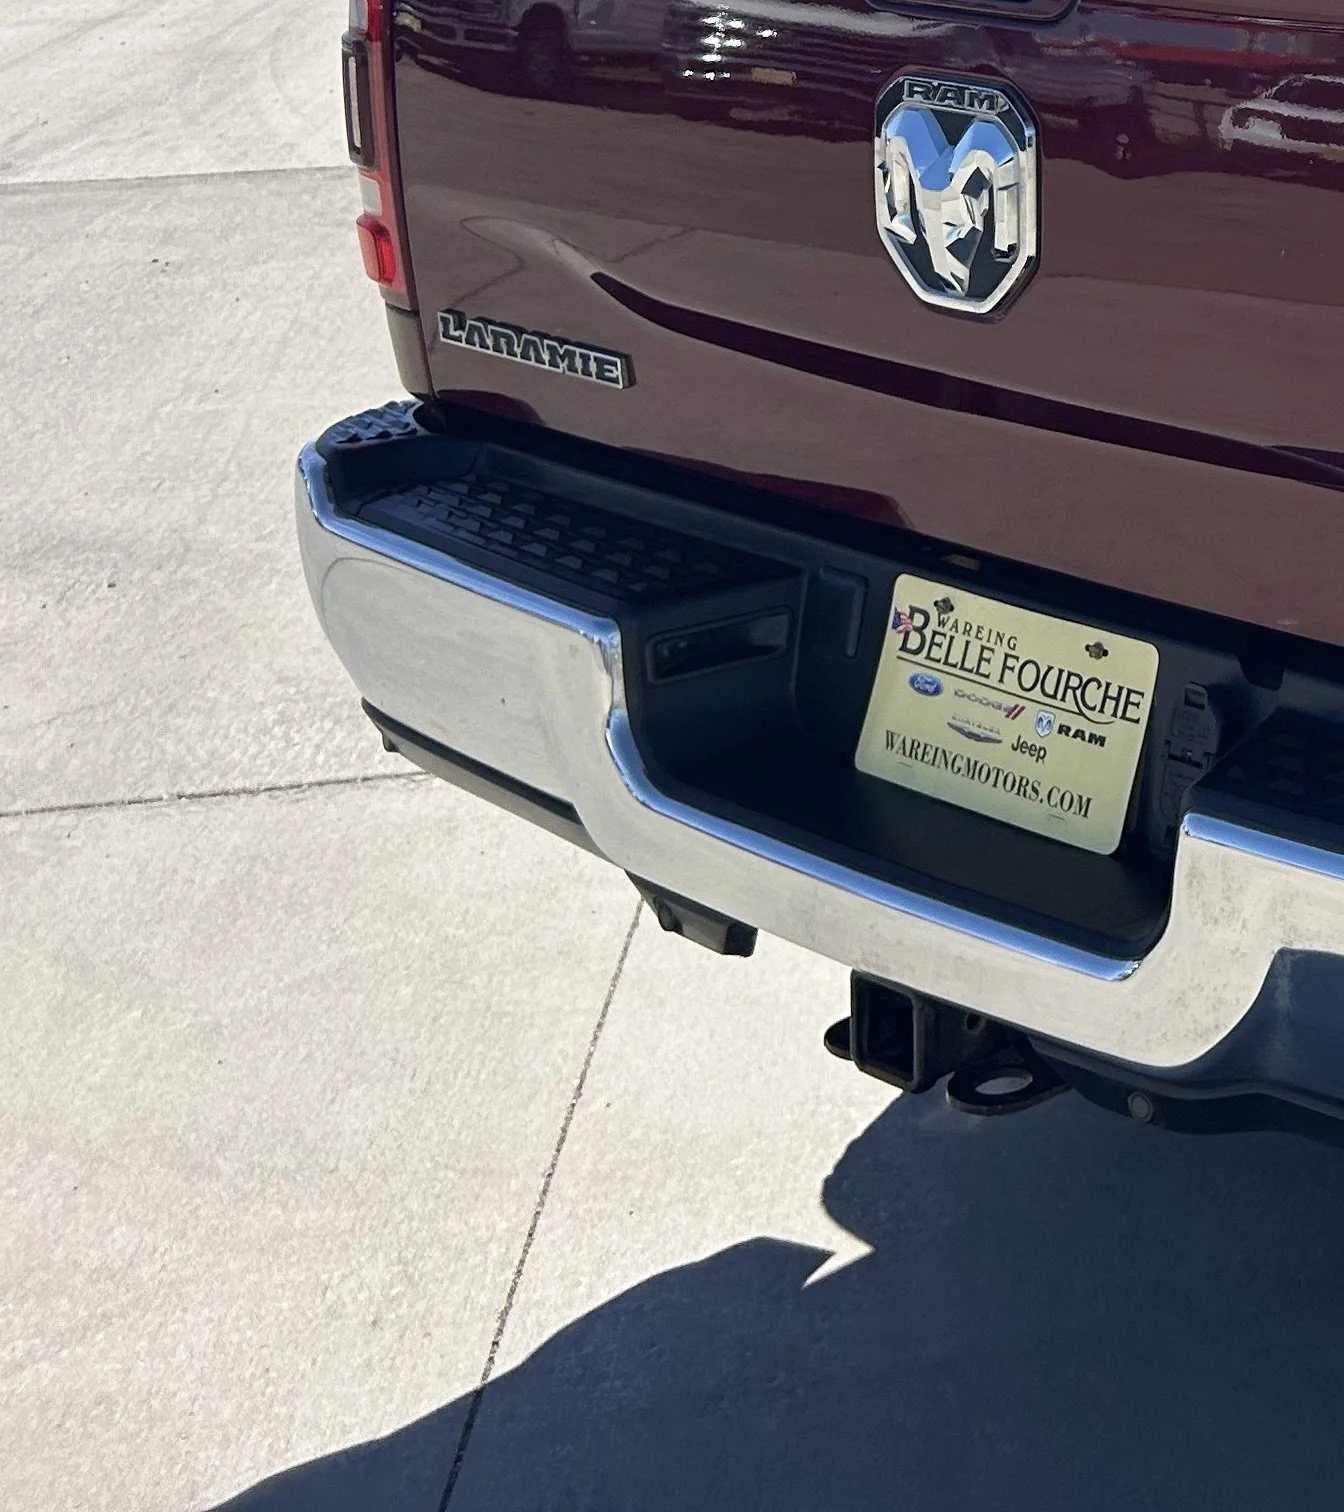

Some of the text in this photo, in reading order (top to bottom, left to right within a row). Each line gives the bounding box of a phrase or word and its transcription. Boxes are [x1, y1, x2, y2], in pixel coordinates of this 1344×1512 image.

[904, 80, 999, 115] RAM
[438, 311, 630, 389] LARAMIE
[937, 613, 1018, 651] WAREING
[899, 605, 1145, 725] BELLE FOURCHE
[1011, 734, 1047, 763] Jeep
[1057, 723, 1106, 747] RAM
[885, 729, 1093, 818] WAREINGMOTORS.COM
